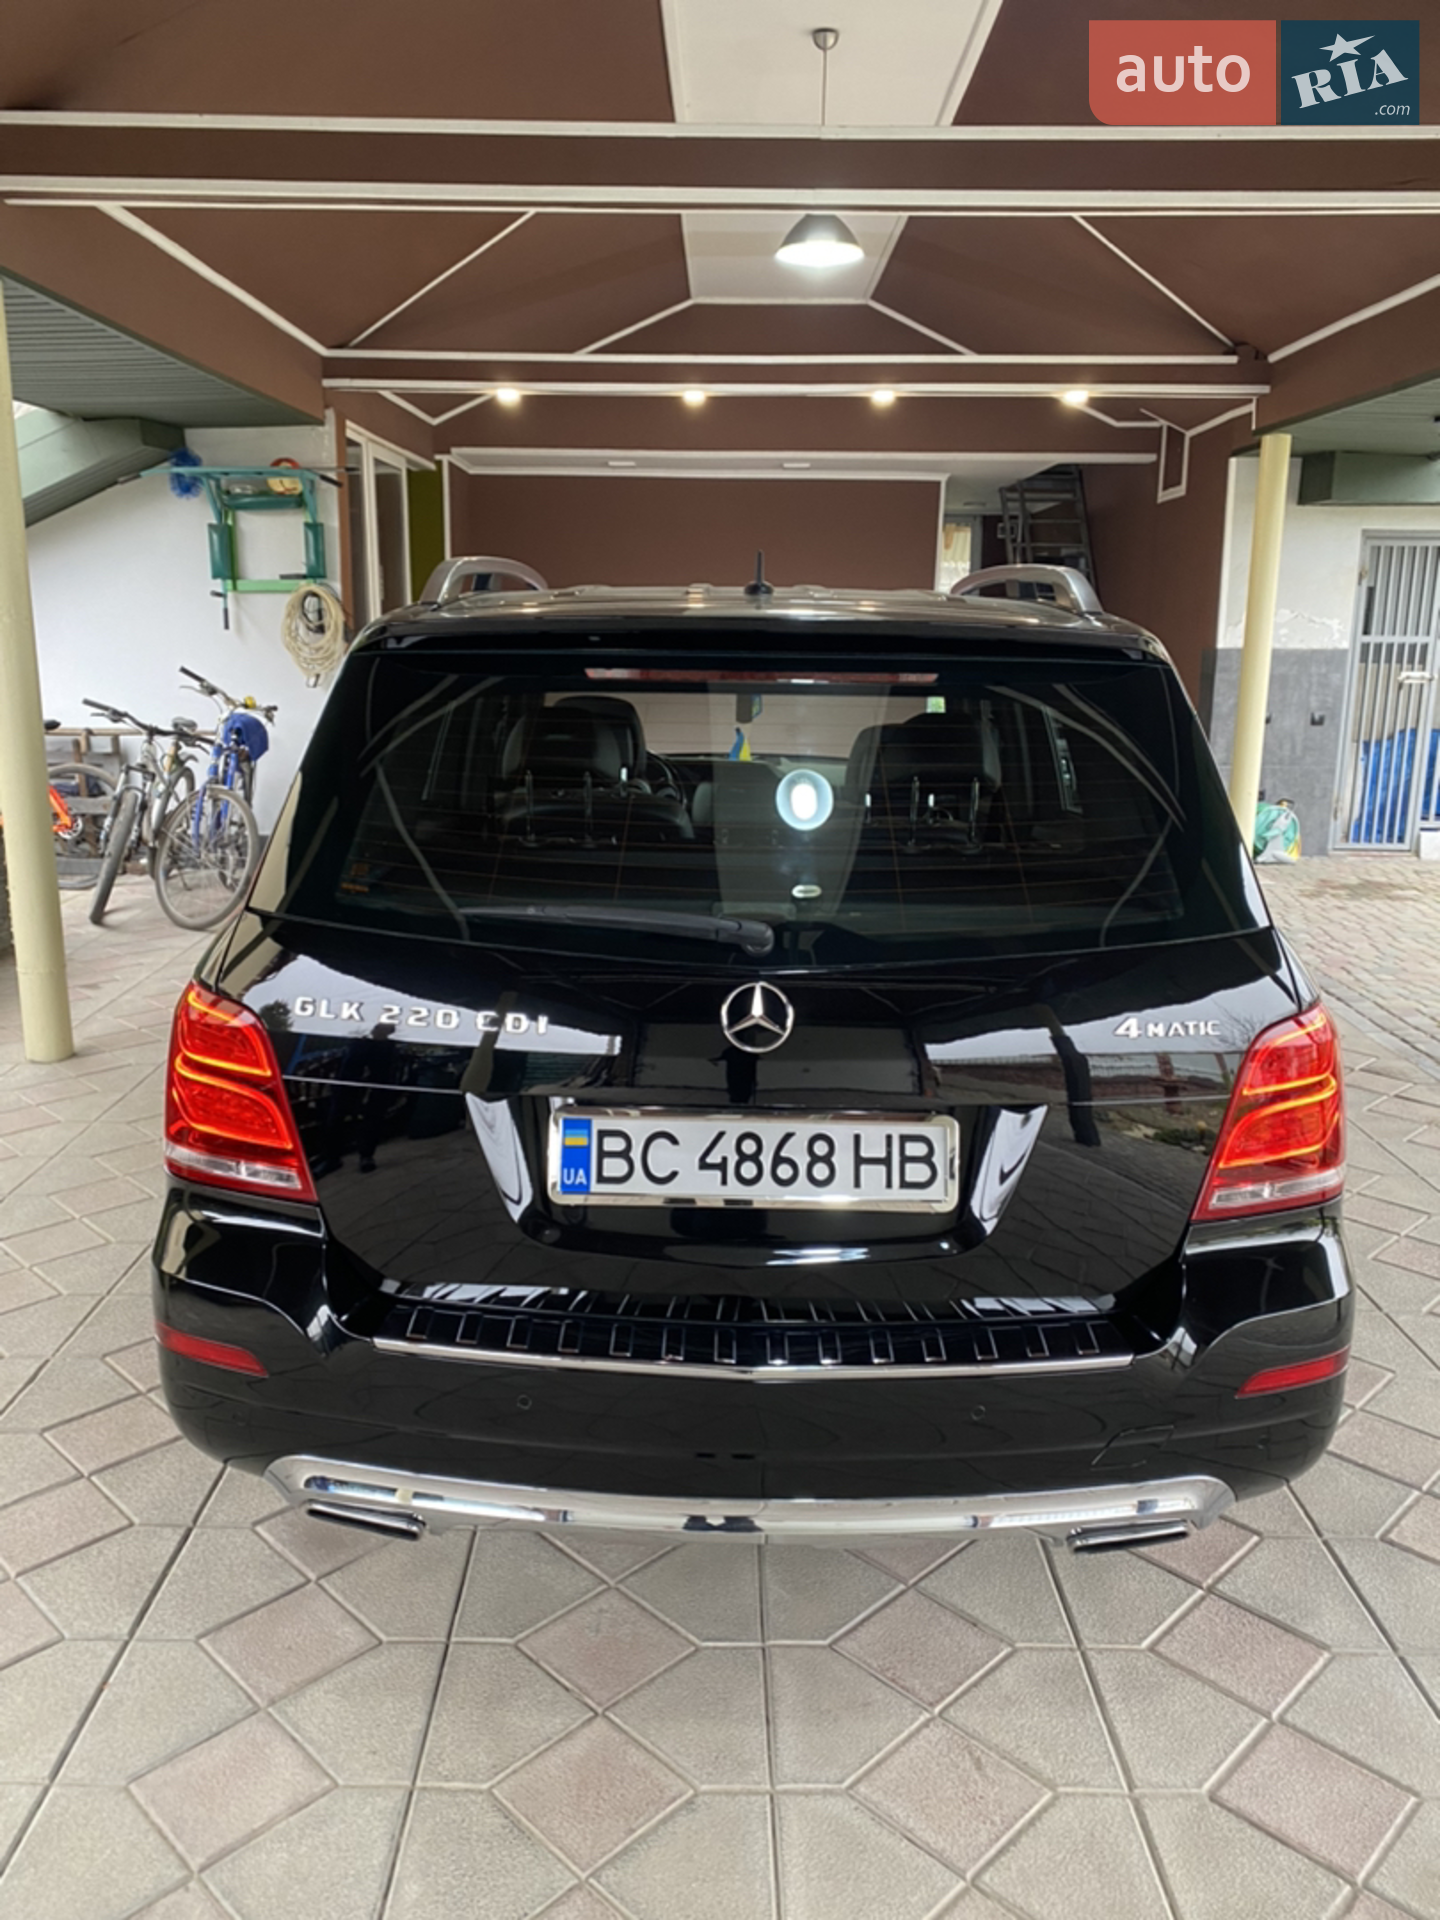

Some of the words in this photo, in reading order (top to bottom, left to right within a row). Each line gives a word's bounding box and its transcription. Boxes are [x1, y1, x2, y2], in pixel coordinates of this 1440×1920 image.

[294, 996, 364, 1021] GLK
[378, 1004, 459, 1029] 220
[475, 1010, 549, 1035] CDI
[563, 1168, 587, 1185] UA
[596, 1129, 680, 1185] BC
[698, 1131, 836, 1187] 4868
[853, 1133, 938, 1189] HB
